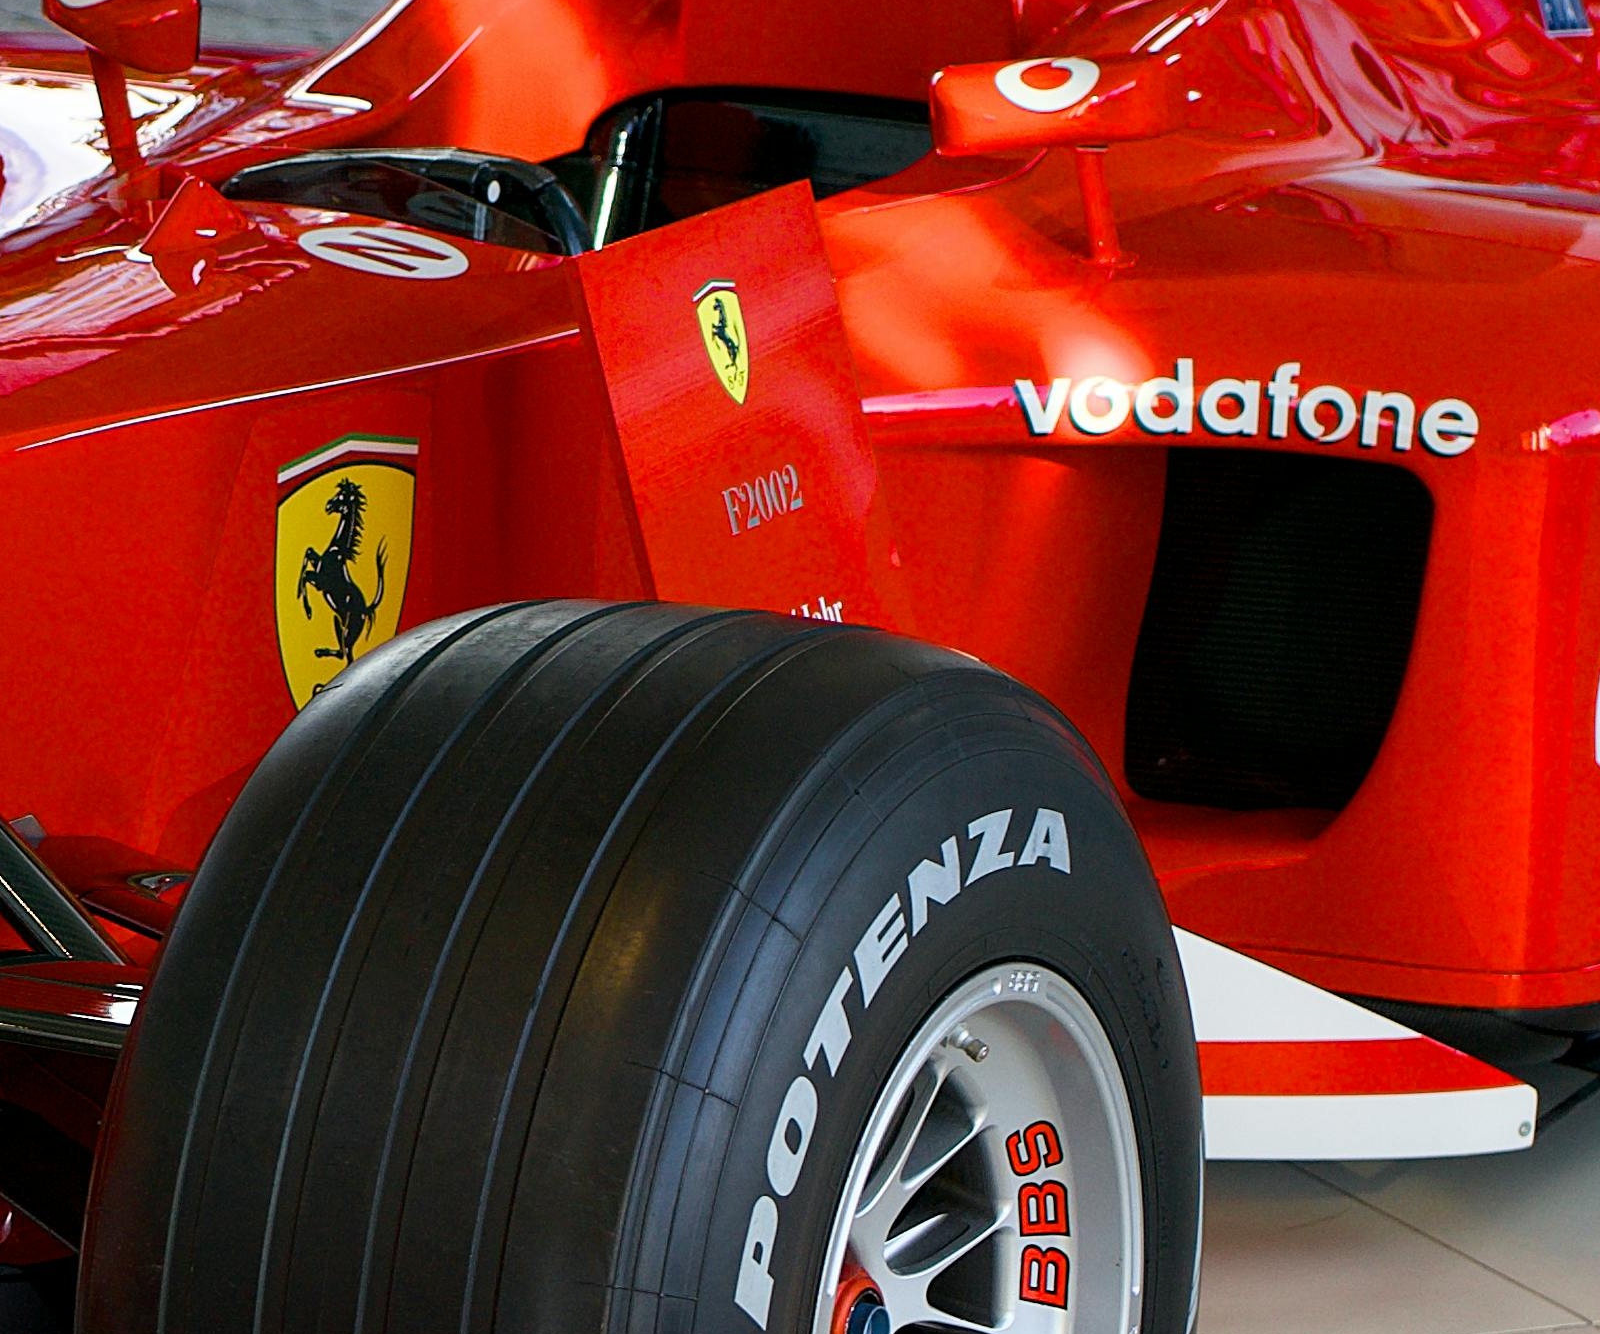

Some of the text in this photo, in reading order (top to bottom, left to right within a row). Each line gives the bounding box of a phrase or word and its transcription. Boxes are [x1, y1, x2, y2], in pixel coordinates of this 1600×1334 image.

[1013, 357, 1479, 457] vodafone
[721, 463, 804, 537] F2002
[734, 806, 1072, 1331] POTENZA
[1005, 1120, 1071, 1310] BBS
